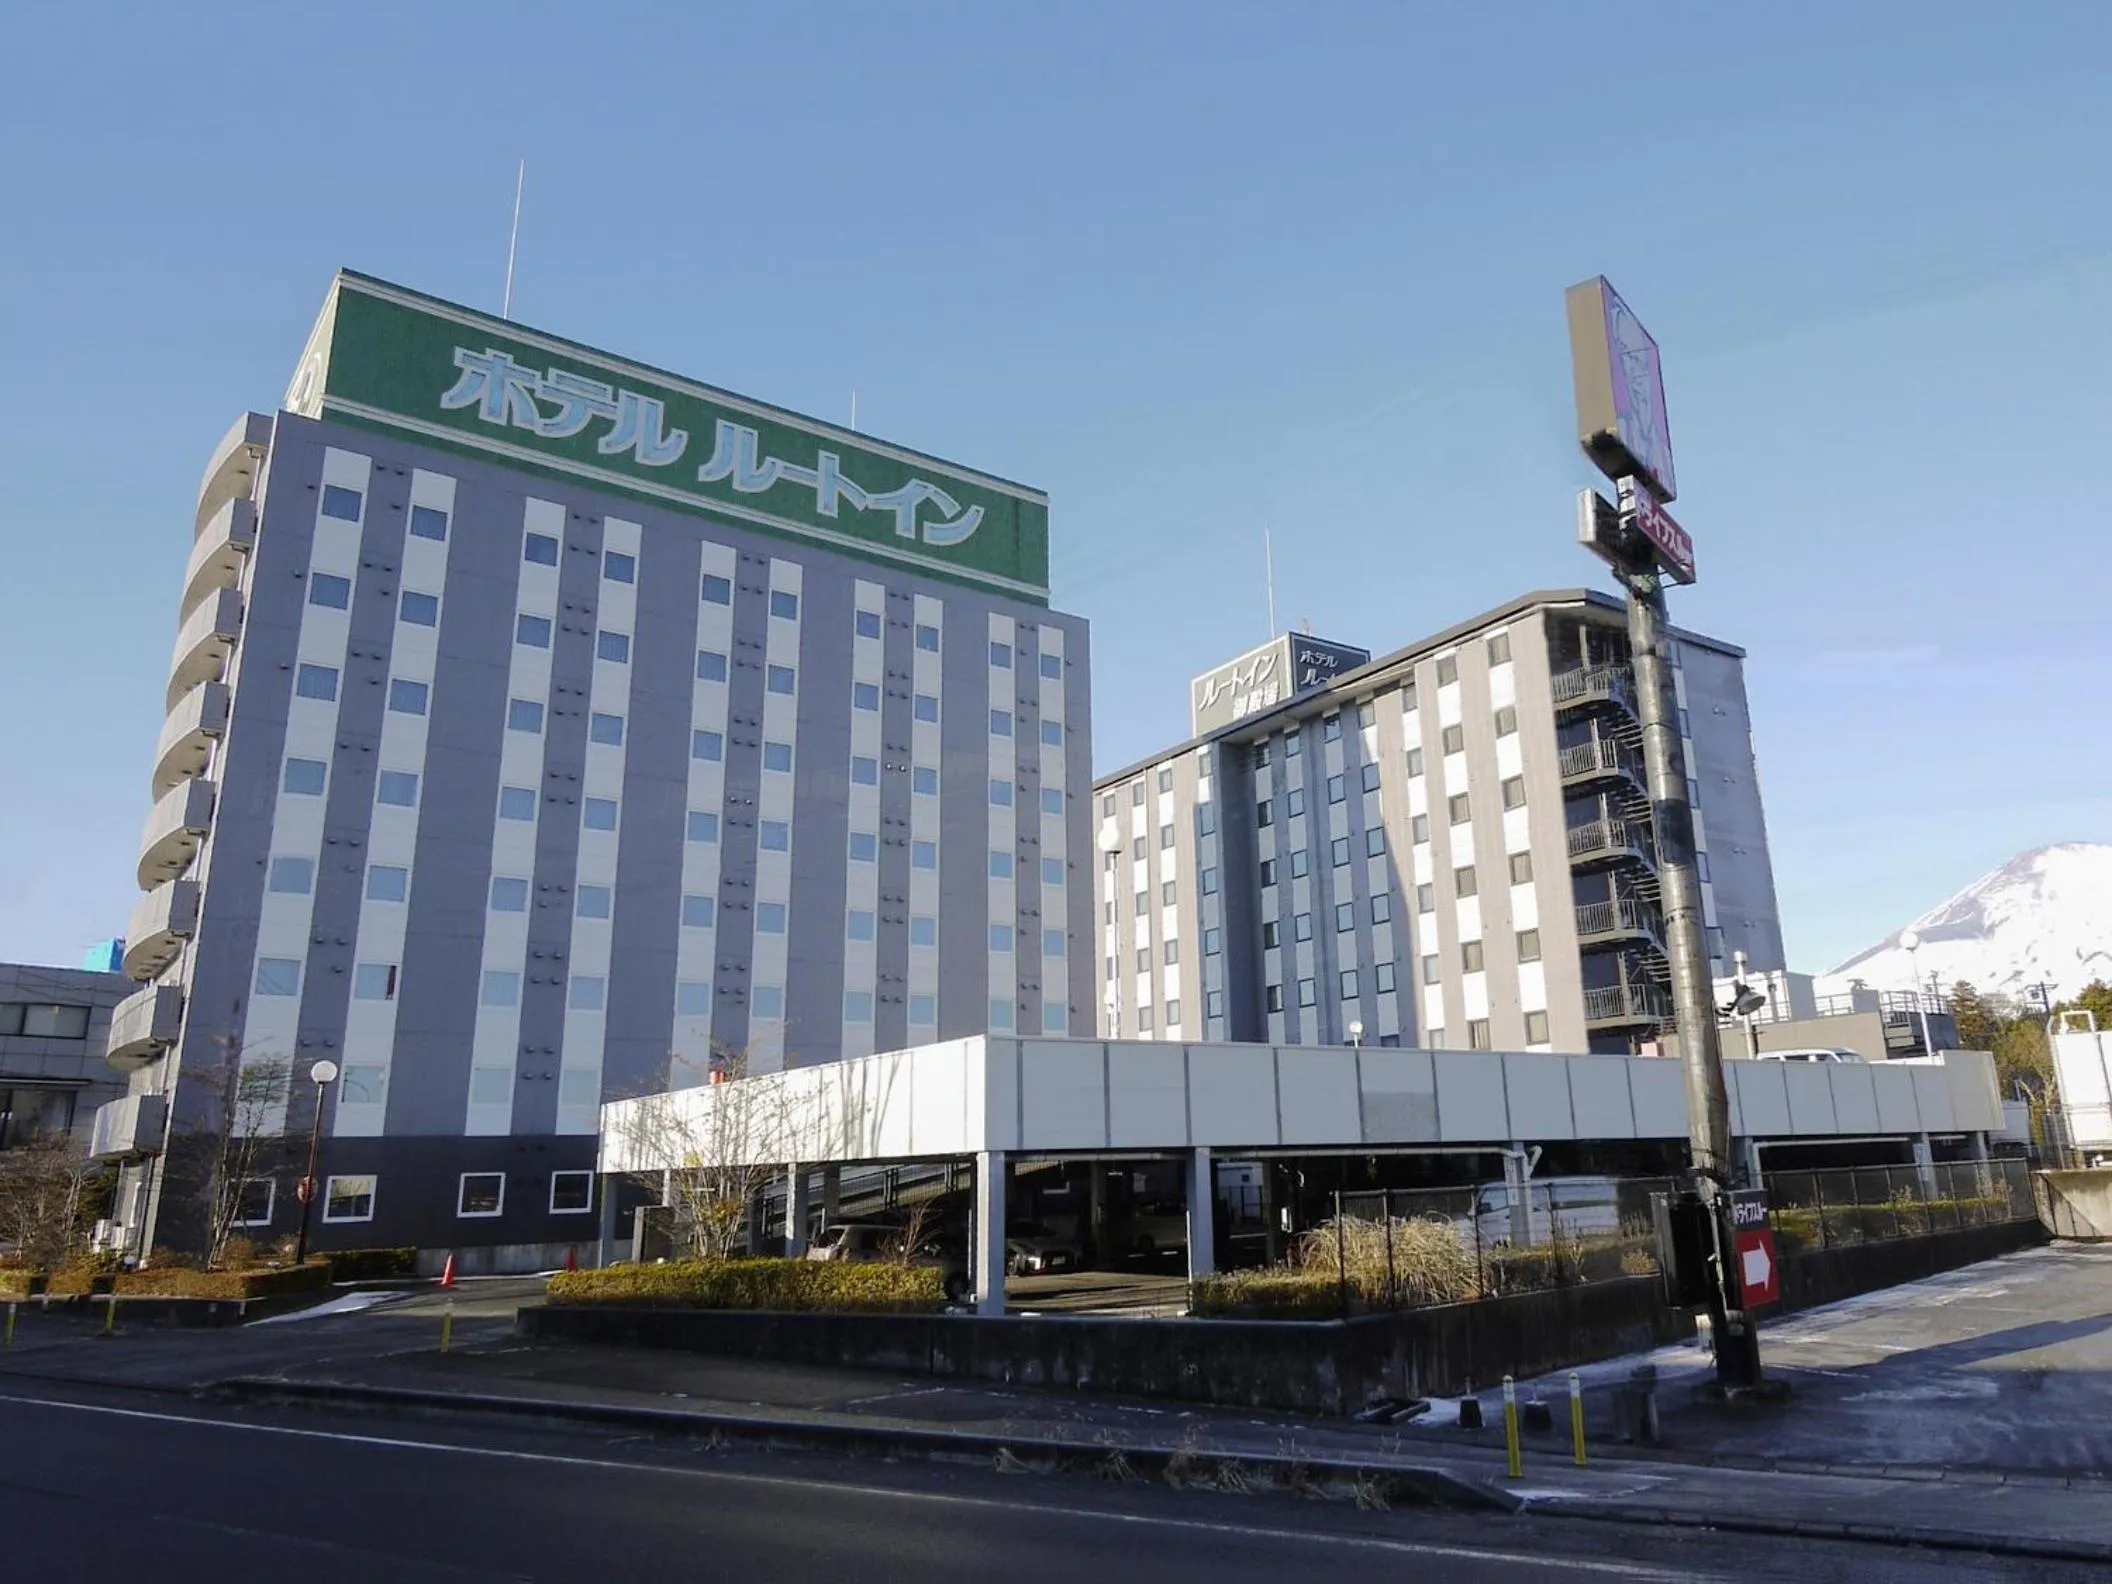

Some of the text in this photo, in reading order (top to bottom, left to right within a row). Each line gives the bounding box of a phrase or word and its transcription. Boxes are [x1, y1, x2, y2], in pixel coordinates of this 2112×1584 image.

[440, 346, 688, 466] ホテル
[698, 419, 985, 546] ルートイン
[1198, 653, 1279, 711] ルートイン
[1300, 649, 1339, 668] ホテル
